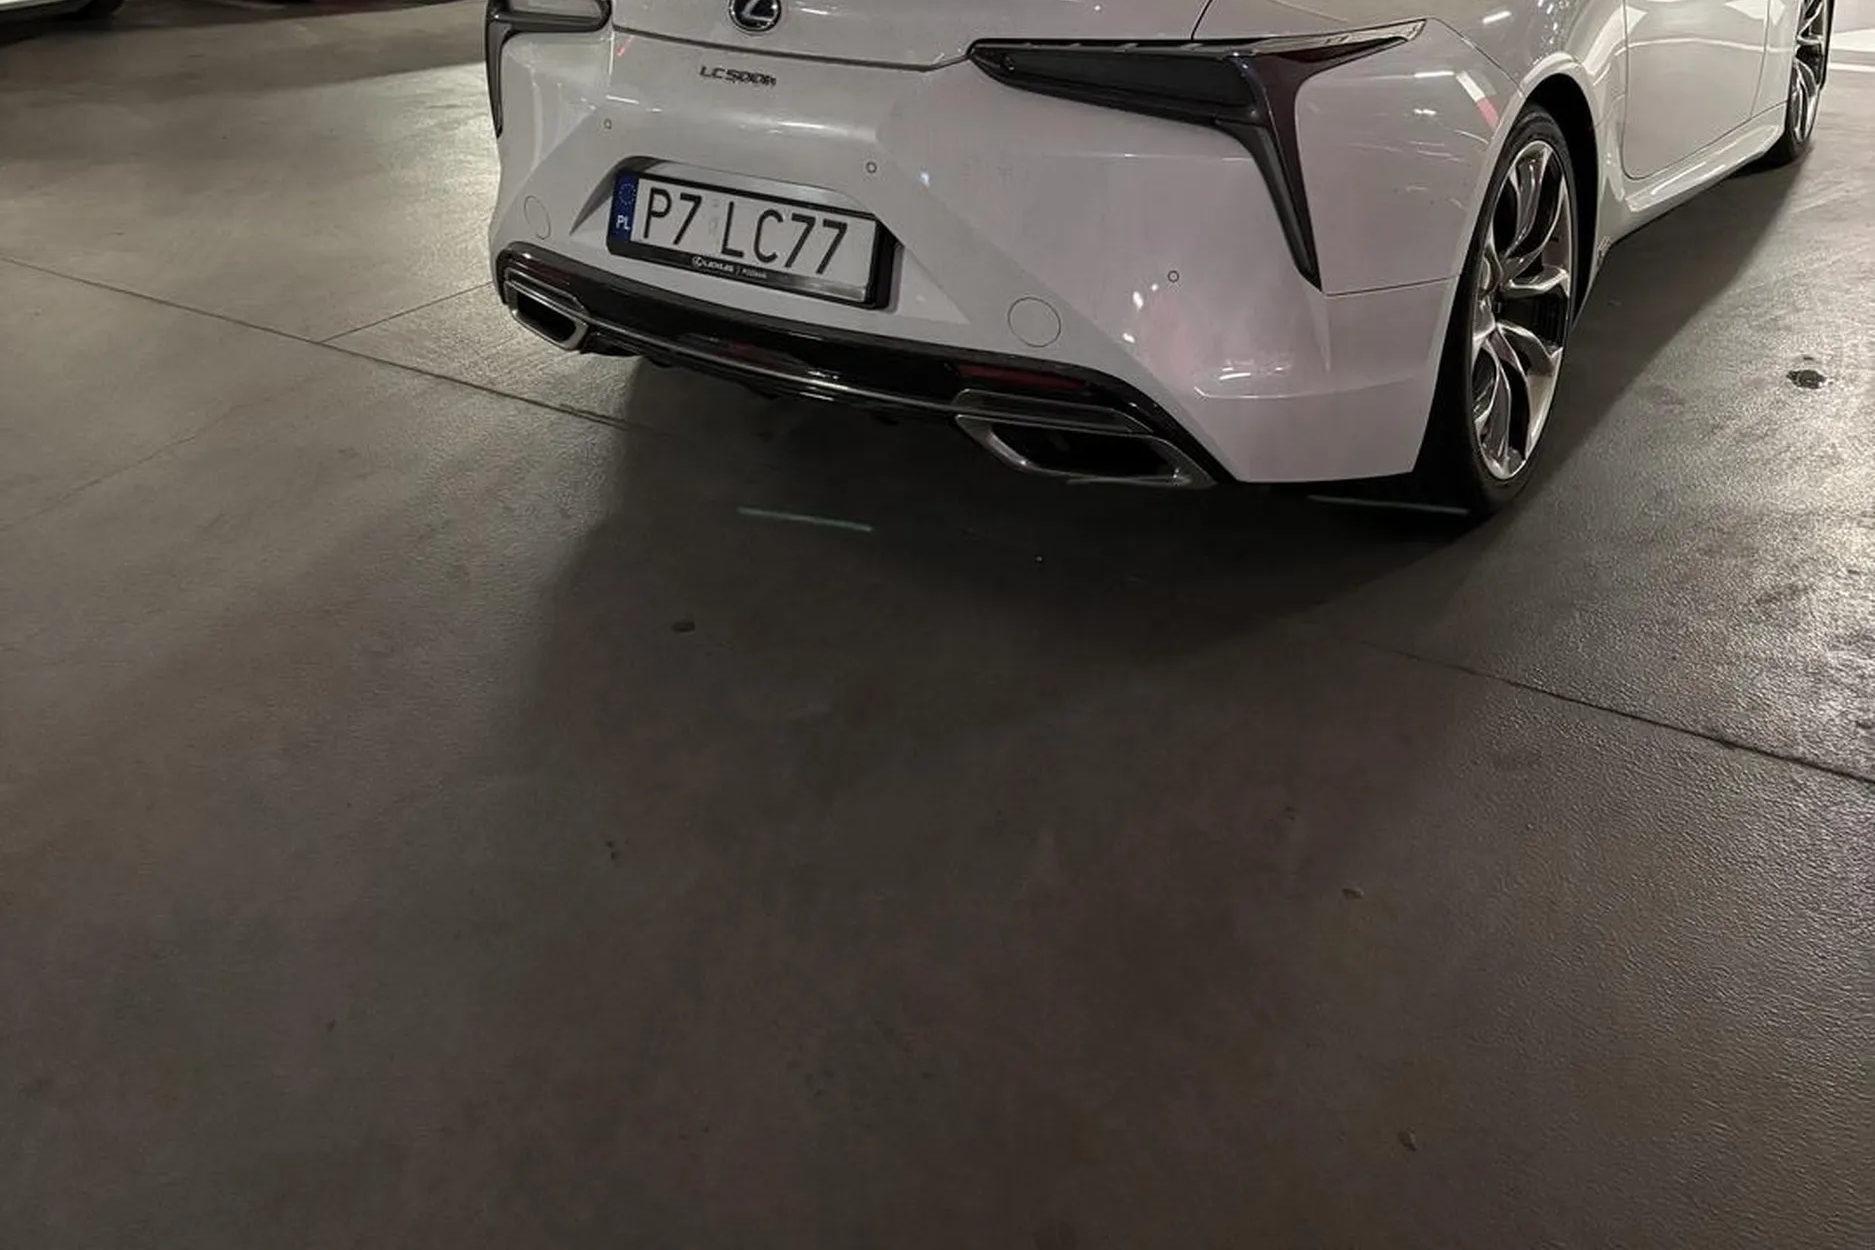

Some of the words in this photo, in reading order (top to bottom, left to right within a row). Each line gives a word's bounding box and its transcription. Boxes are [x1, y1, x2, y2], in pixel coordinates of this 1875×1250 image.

[615, 214, 631, 230] PL
[643, 186, 702, 245] P7
[720, 200, 848, 274] LC77
